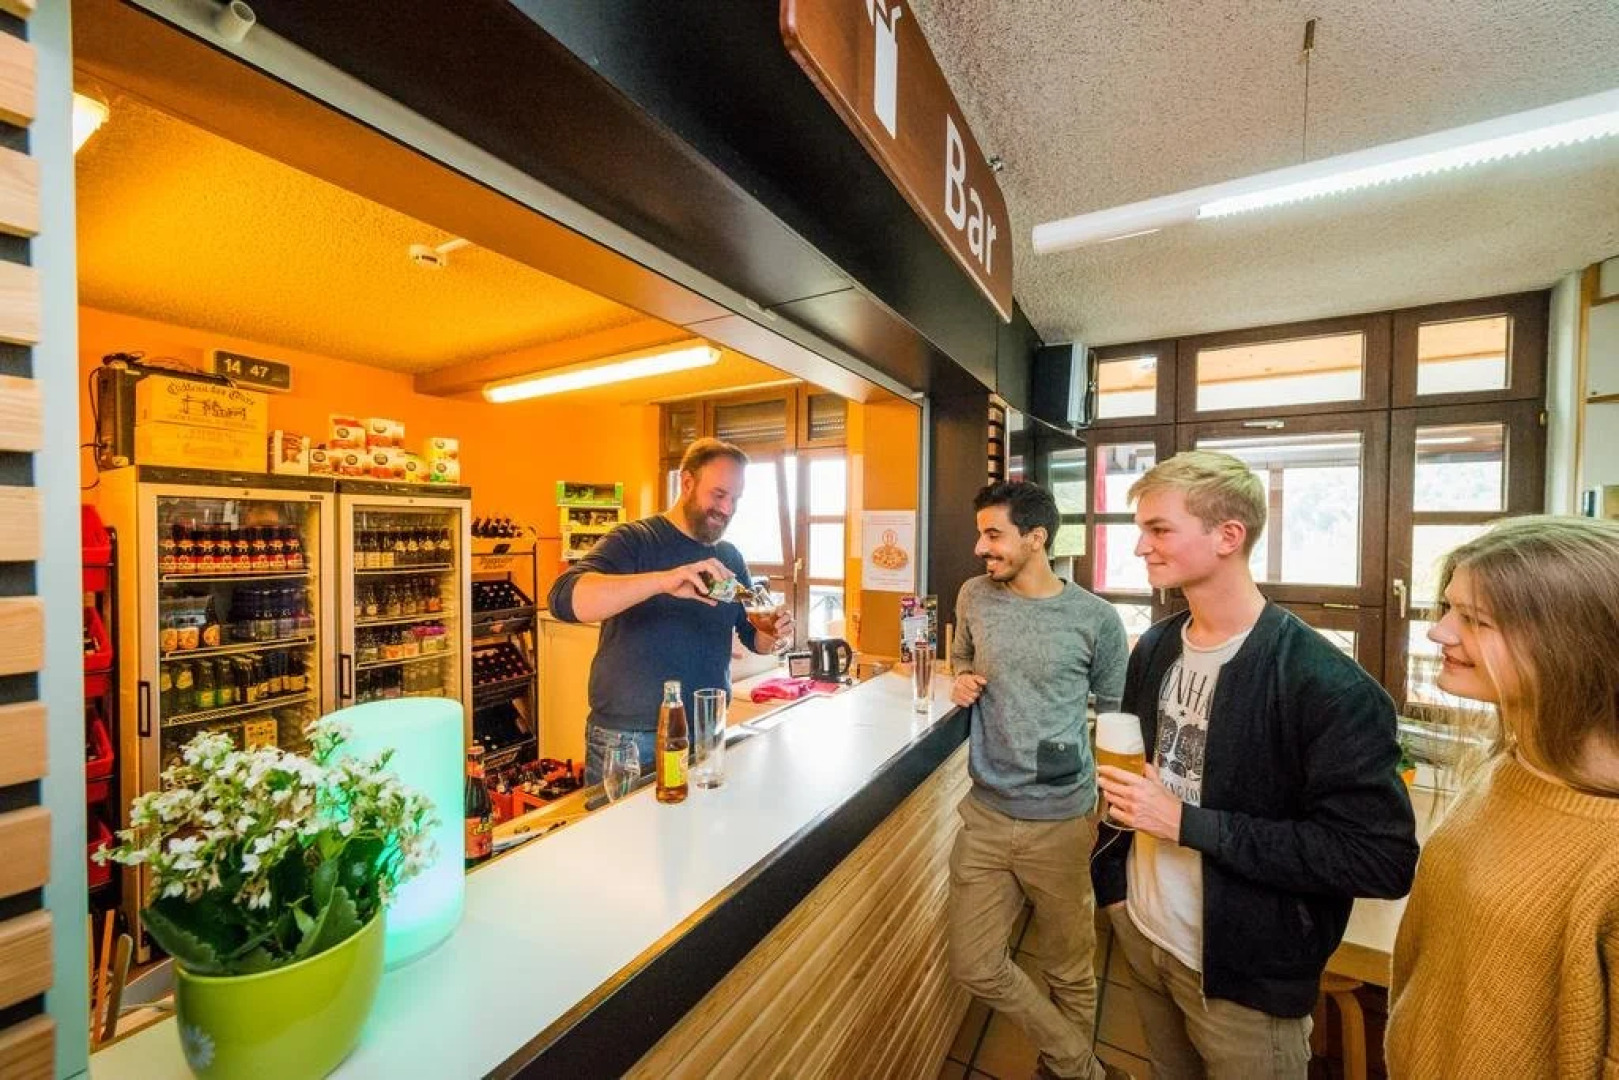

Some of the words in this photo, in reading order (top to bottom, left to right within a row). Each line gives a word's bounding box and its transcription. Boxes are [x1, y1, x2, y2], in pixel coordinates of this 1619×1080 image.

[944, 113, 997, 275] Bar
[223, 358, 242, 374] 14
[249, 364, 270, 379] 47
